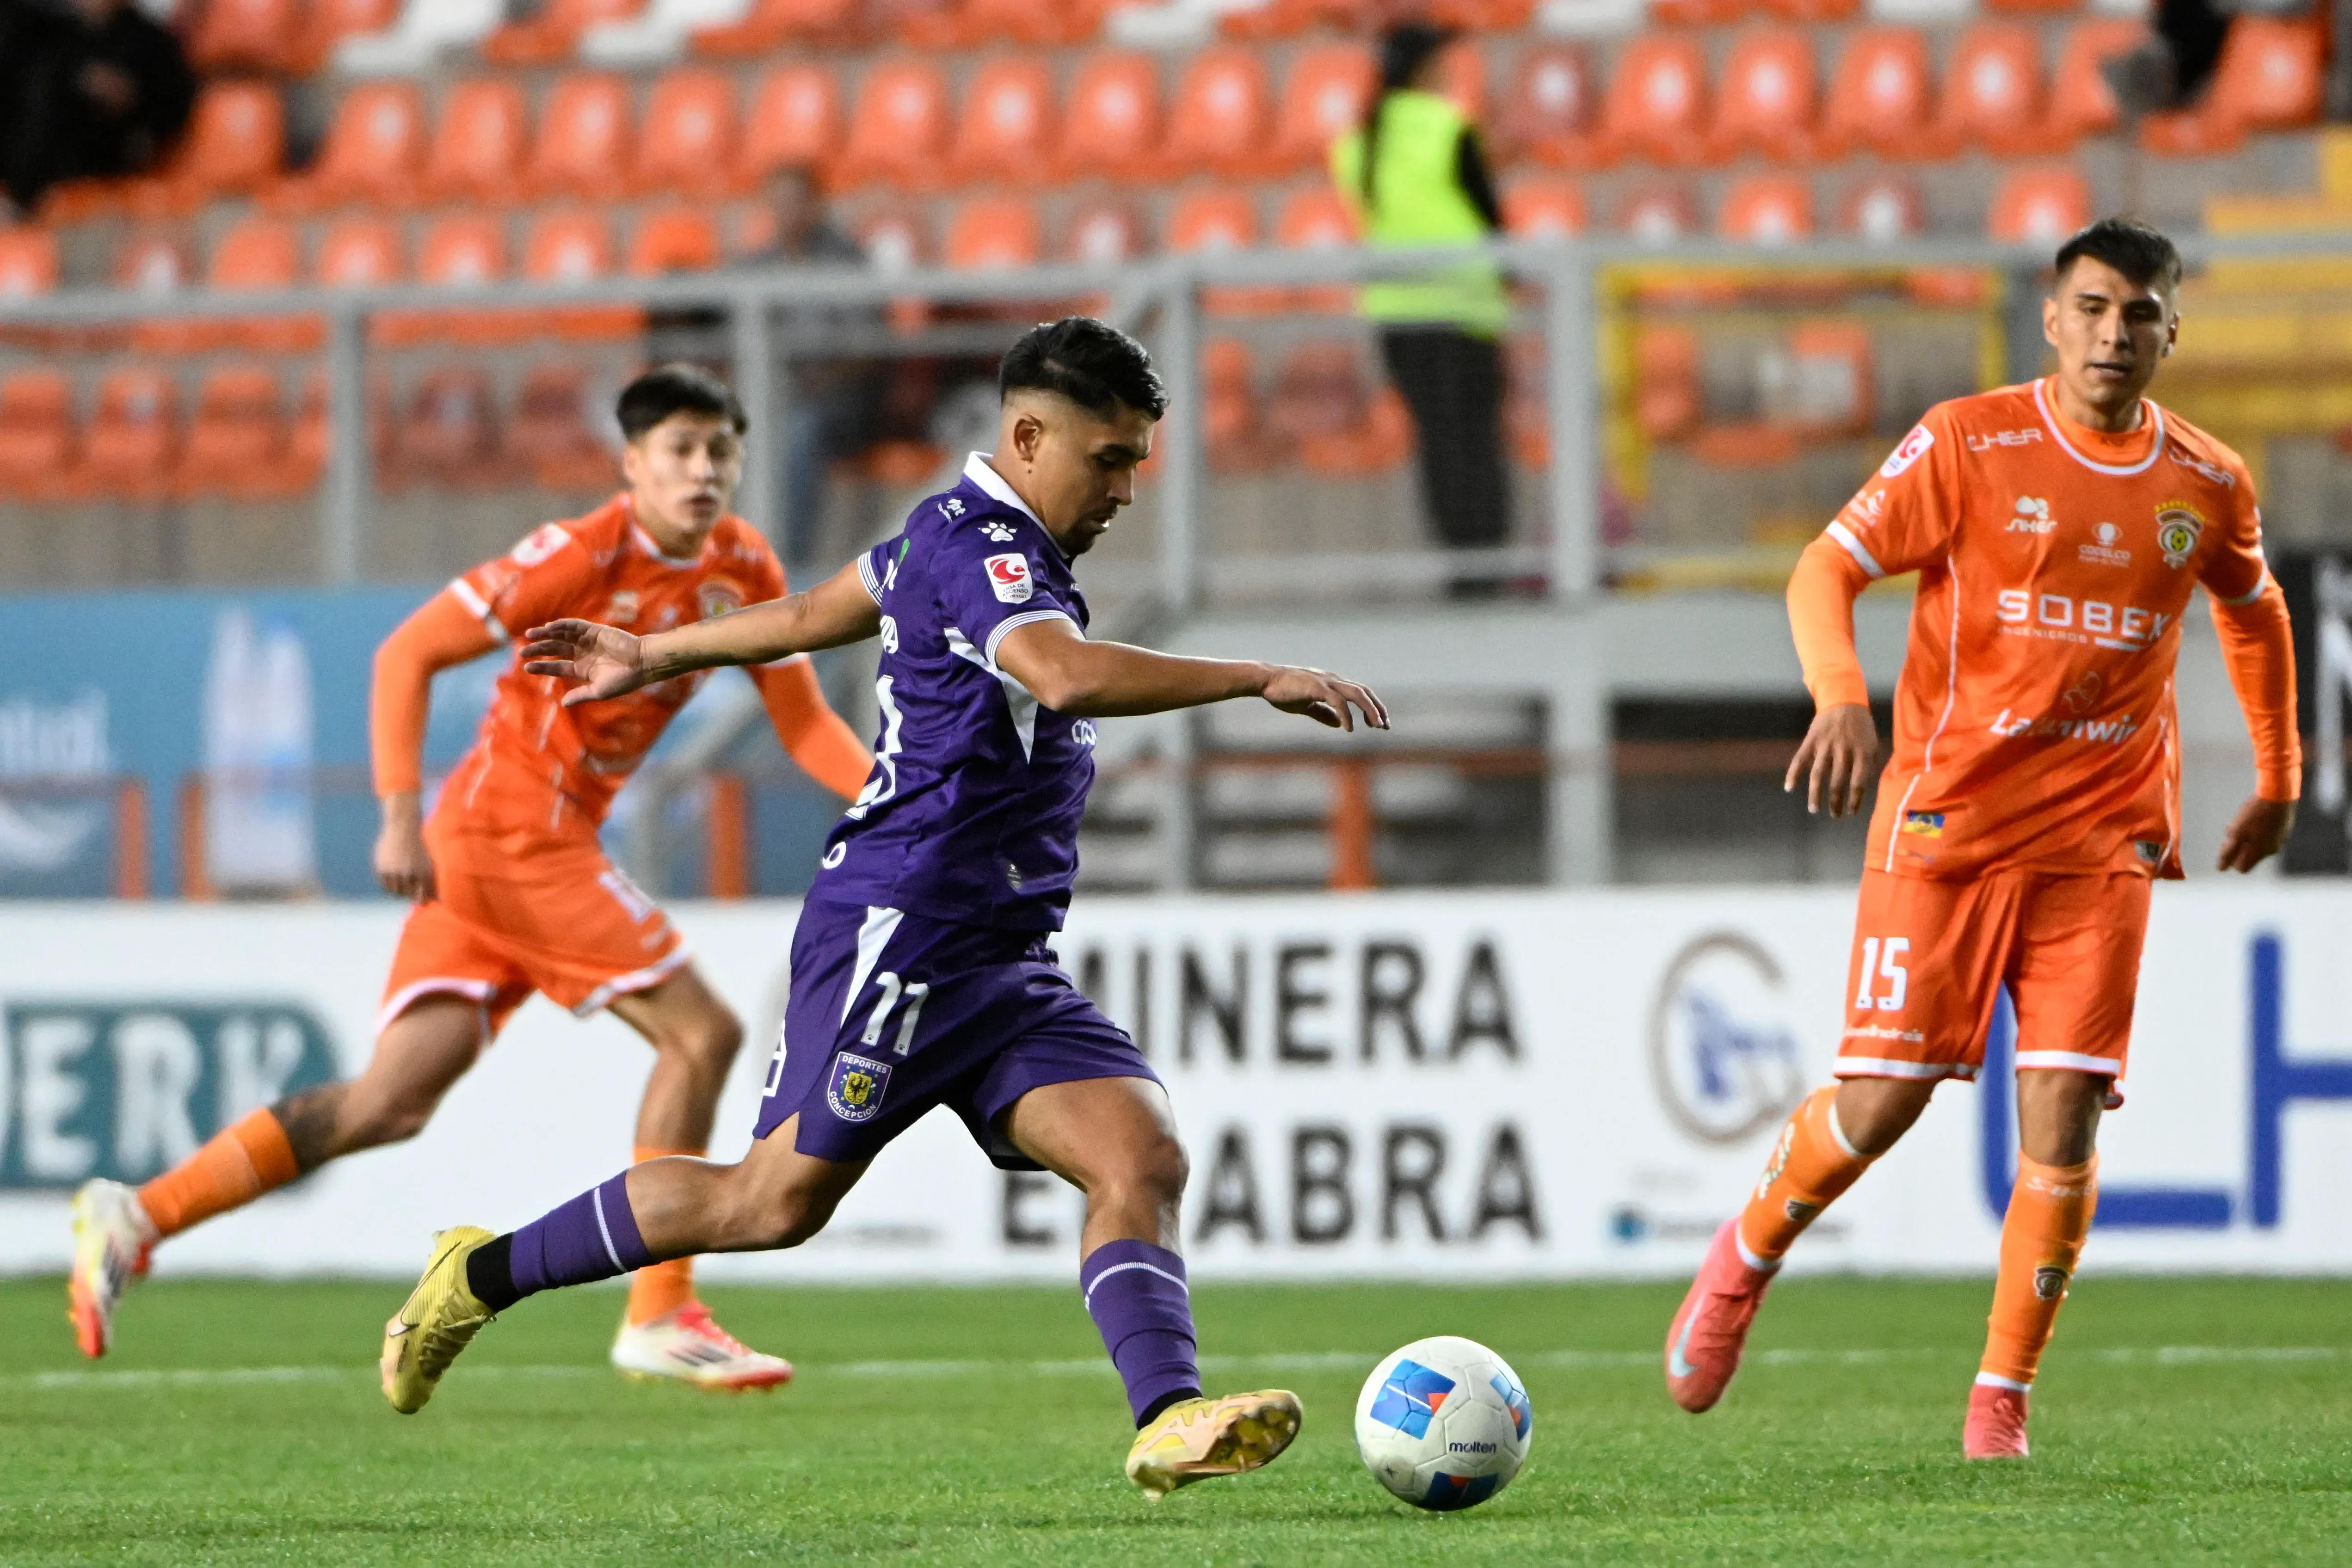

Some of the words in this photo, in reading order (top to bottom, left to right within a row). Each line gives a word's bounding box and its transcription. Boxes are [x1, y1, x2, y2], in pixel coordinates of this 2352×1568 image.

[1855, 937, 1910, 1011] 15
[842, 1055, 887, 1074] DEPORTES
[0, 1014, 305, 1180] ERK
[830, 1091, 877, 1118] CONCEPCION
[1194, 1124, 1545, 1246] ABRA
[1449, 1441, 1497, 1454] molten
